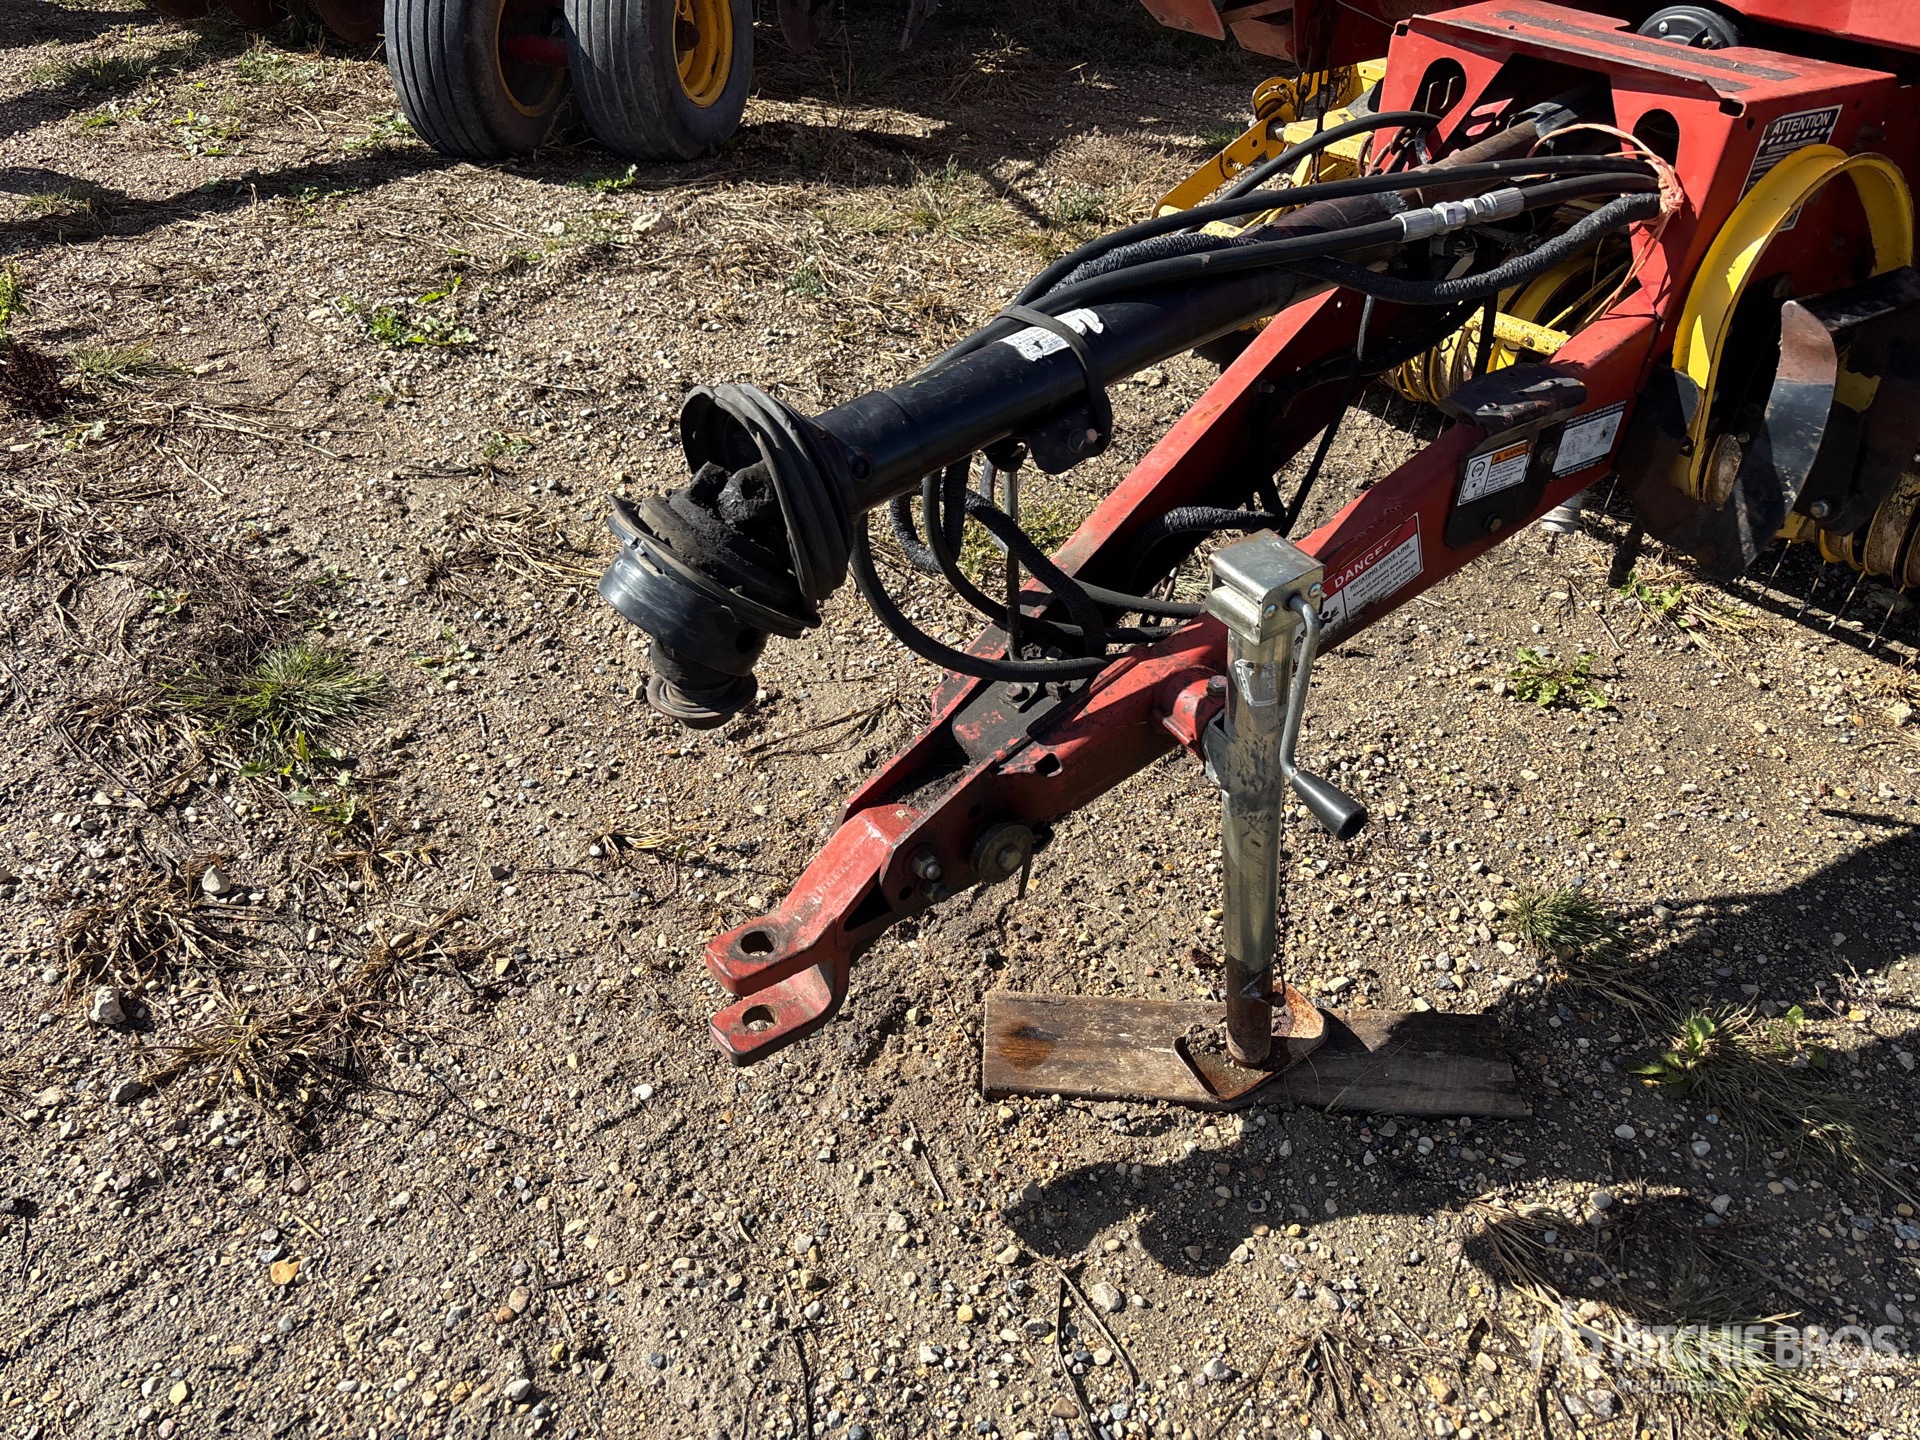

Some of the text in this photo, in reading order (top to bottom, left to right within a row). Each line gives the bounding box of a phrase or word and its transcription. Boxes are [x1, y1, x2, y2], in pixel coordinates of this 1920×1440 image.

[1771, 112, 1831, 135] ATTENTION
[1350, 543, 1411, 591] ROTATING DRIVE LINE
